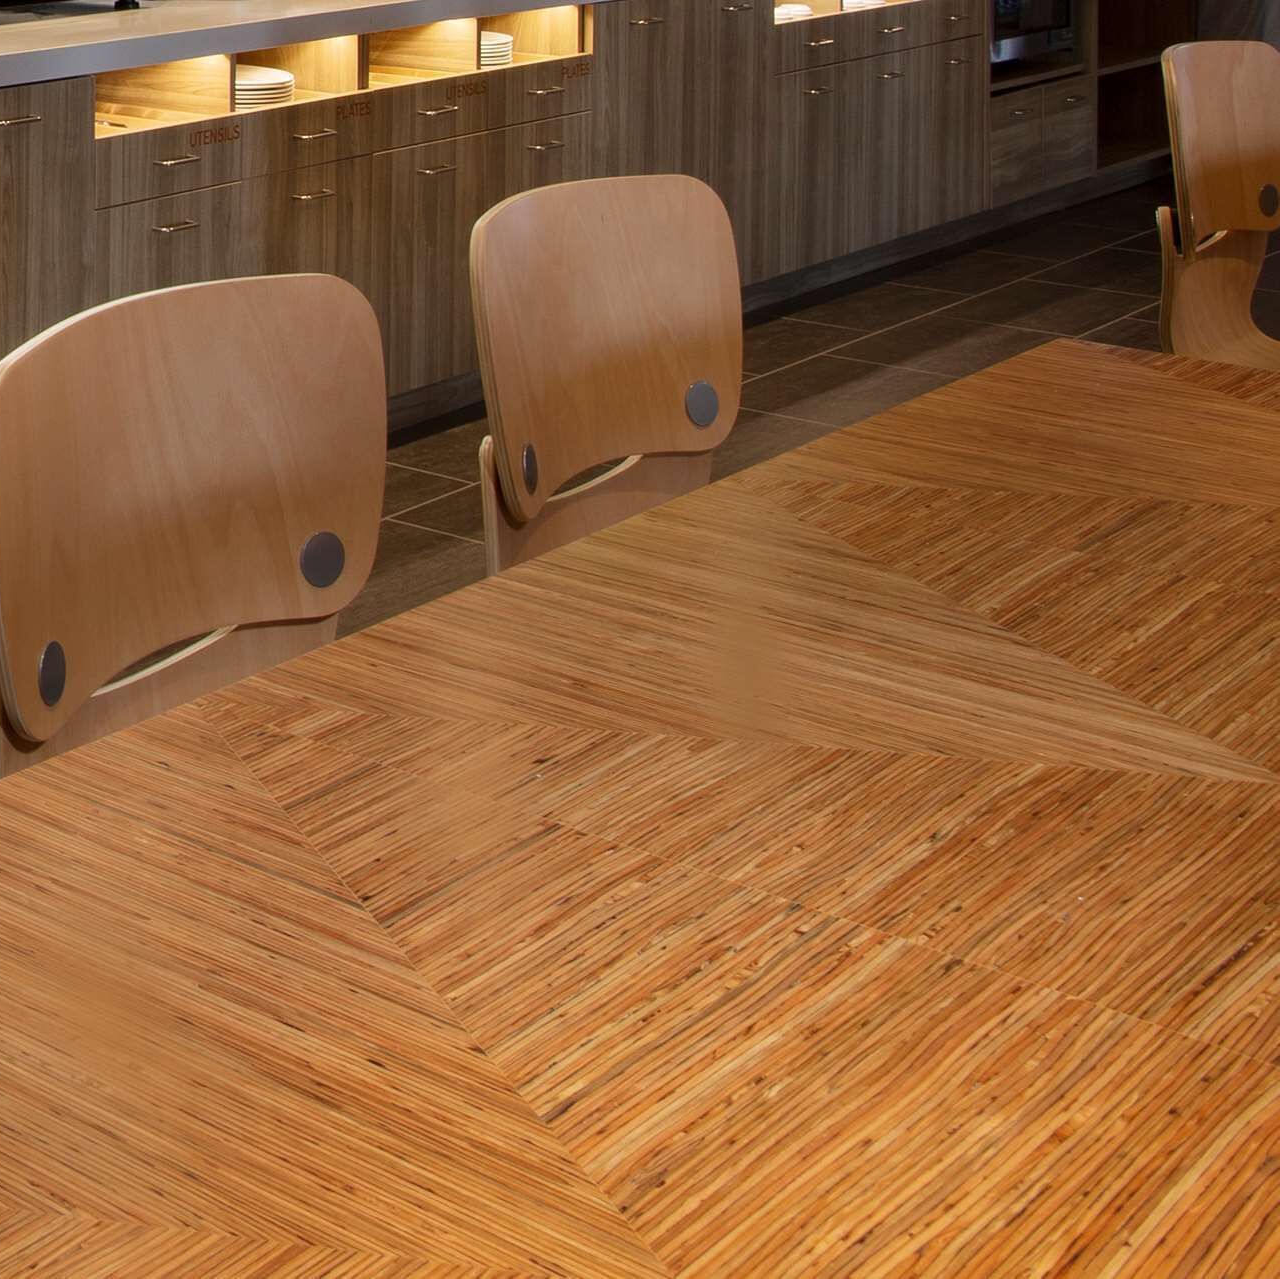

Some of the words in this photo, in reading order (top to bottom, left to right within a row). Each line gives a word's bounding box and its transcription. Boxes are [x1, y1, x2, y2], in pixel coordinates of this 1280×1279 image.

[445, 80, 487, 100] UTENSILS
[337, 102, 371, 120] PLATES
[189, 124, 241, 147] UTENSILS
